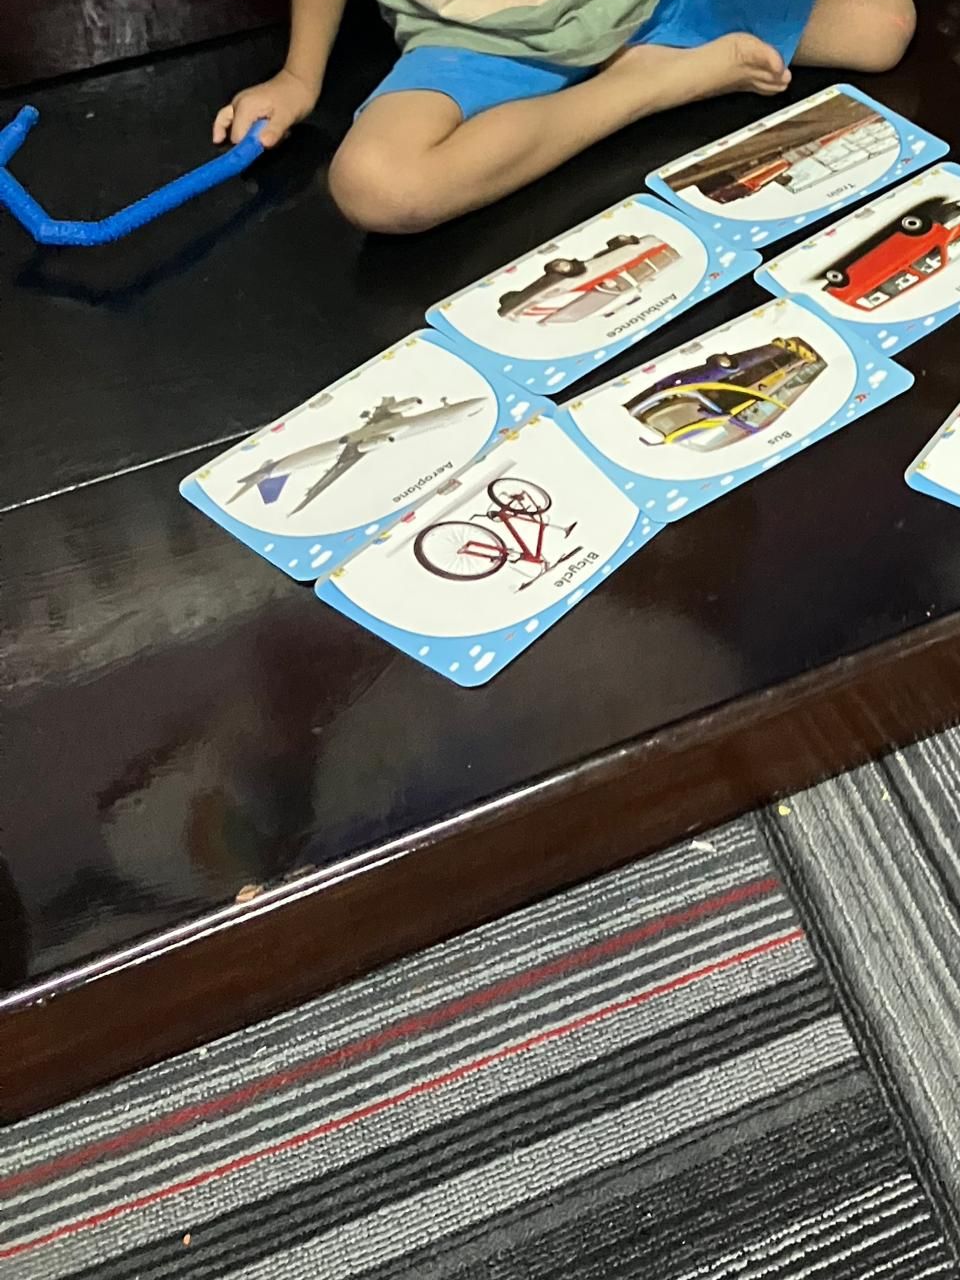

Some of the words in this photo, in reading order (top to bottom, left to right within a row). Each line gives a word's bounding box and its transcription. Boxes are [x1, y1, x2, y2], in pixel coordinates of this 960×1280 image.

[606, 293, 677, 338] Ambulance
[767, 430, 792, 445] Bus
[392, 460, 453, 503] Aeroplane
[553, 551, 600, 588] Bicycle
